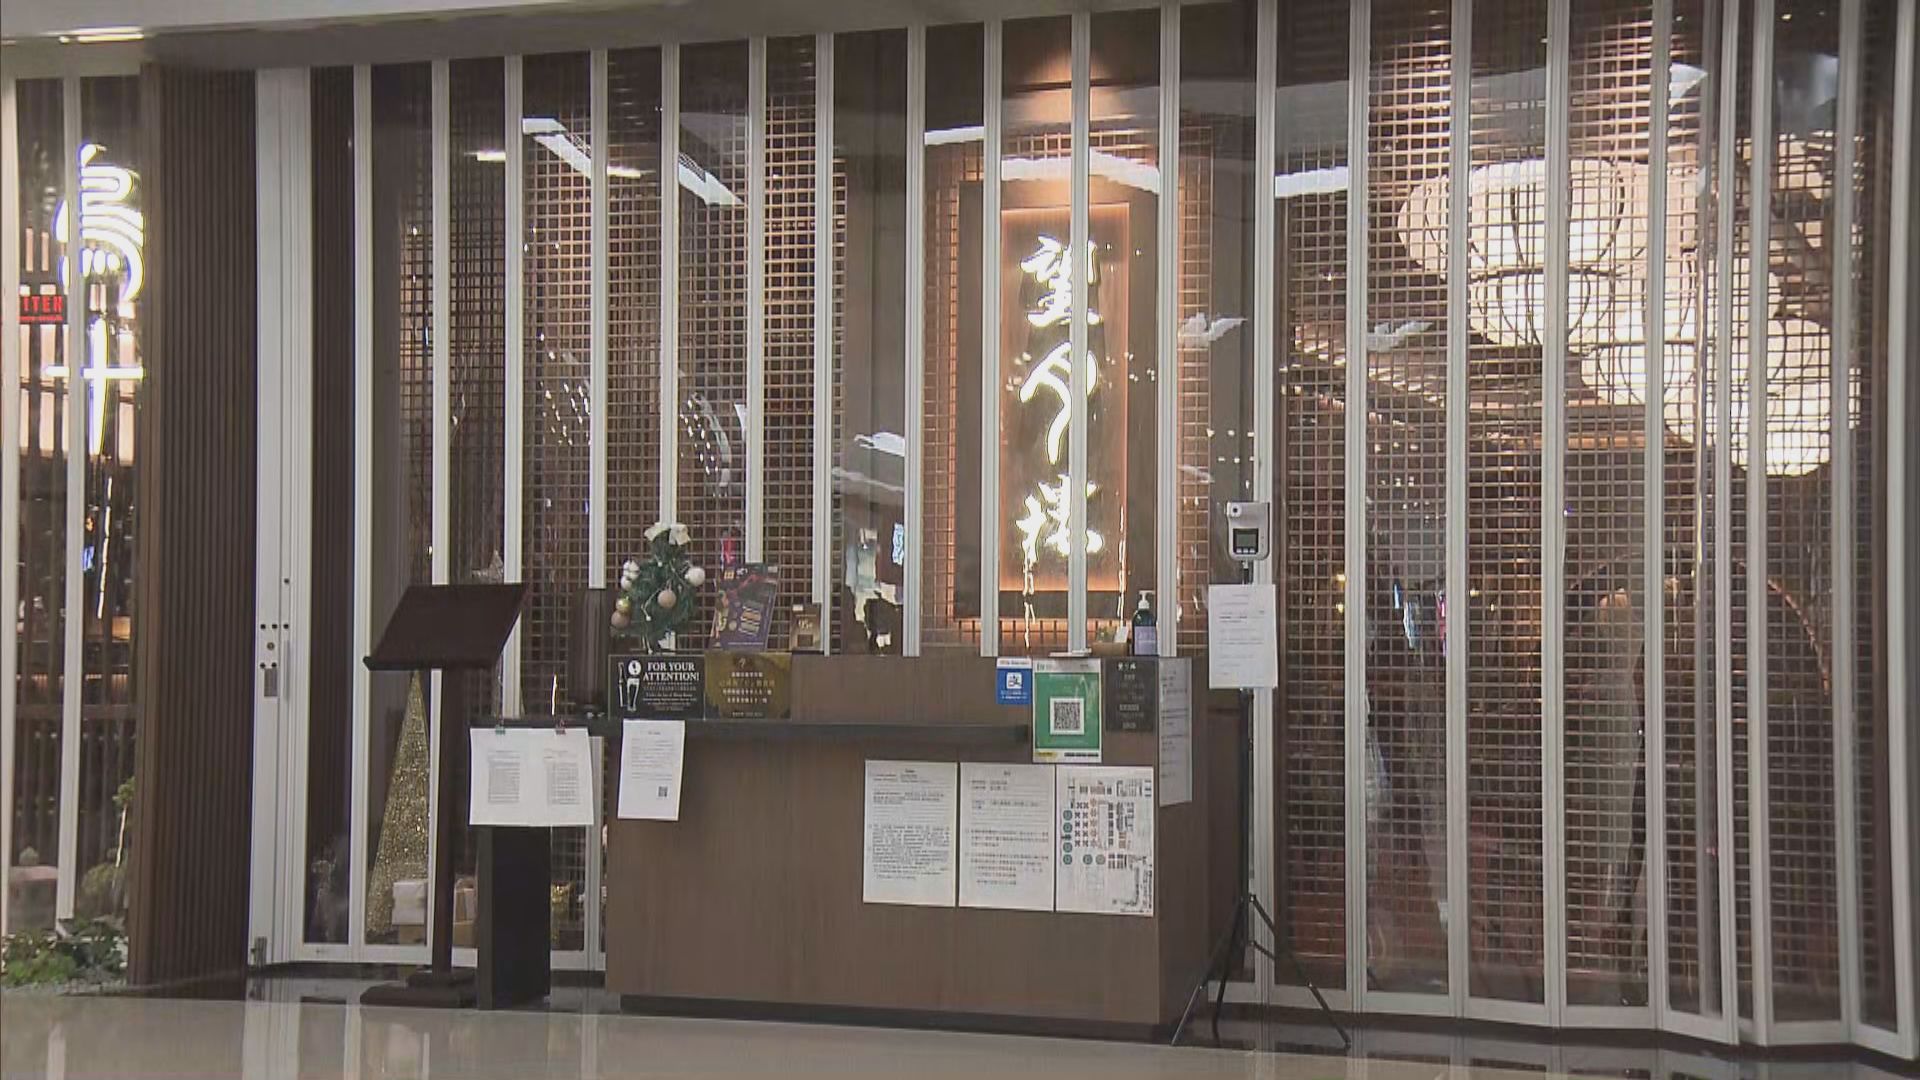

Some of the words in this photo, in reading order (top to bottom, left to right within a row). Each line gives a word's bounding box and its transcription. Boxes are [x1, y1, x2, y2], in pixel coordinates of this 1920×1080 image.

[647, 662, 667, 671] FOR
[668, 662, 695, 671] YOUR
[643, 672, 700, 681] ATTENTION!
